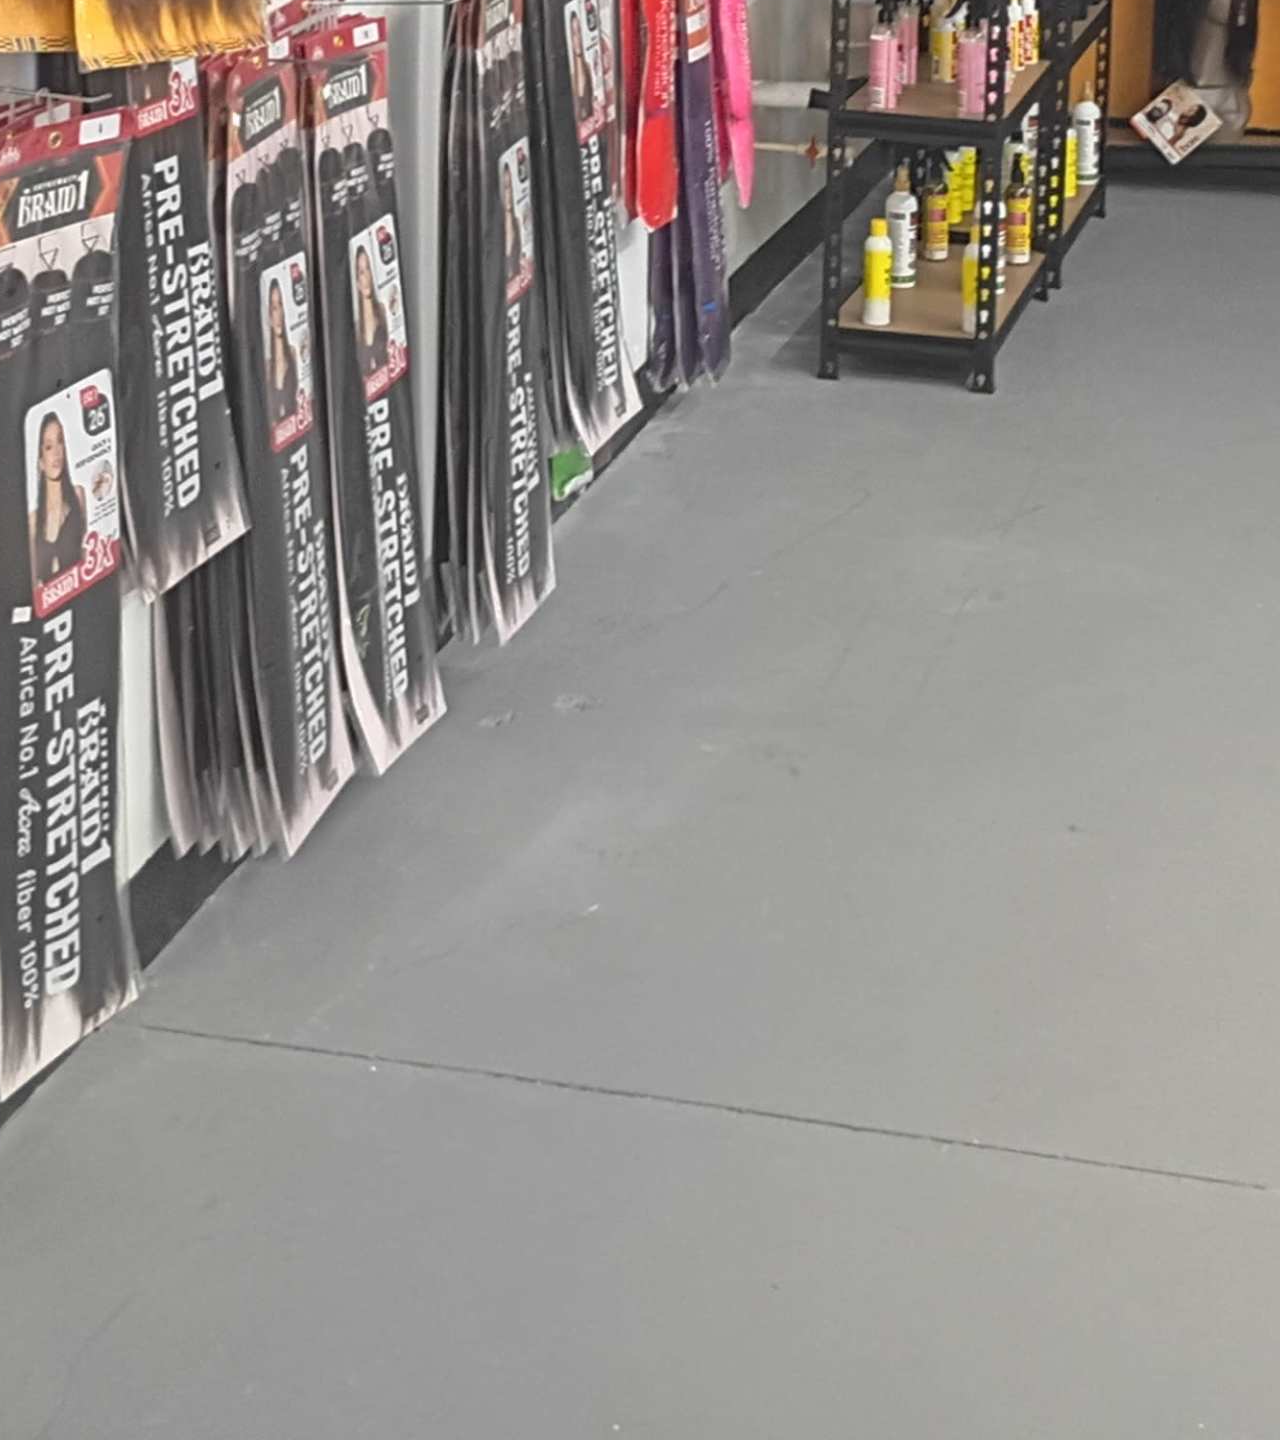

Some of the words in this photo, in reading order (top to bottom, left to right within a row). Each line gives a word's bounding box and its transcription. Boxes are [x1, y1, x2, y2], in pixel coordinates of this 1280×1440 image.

[152, 154, 201, 510] PRE-STRETCHED
[288, 443, 331, 765] PRE-STRETCHED
[365, 397, 410, 700] PRE-STRETCHED
[42, 609, 82, 996] PRE-STRETCHED
